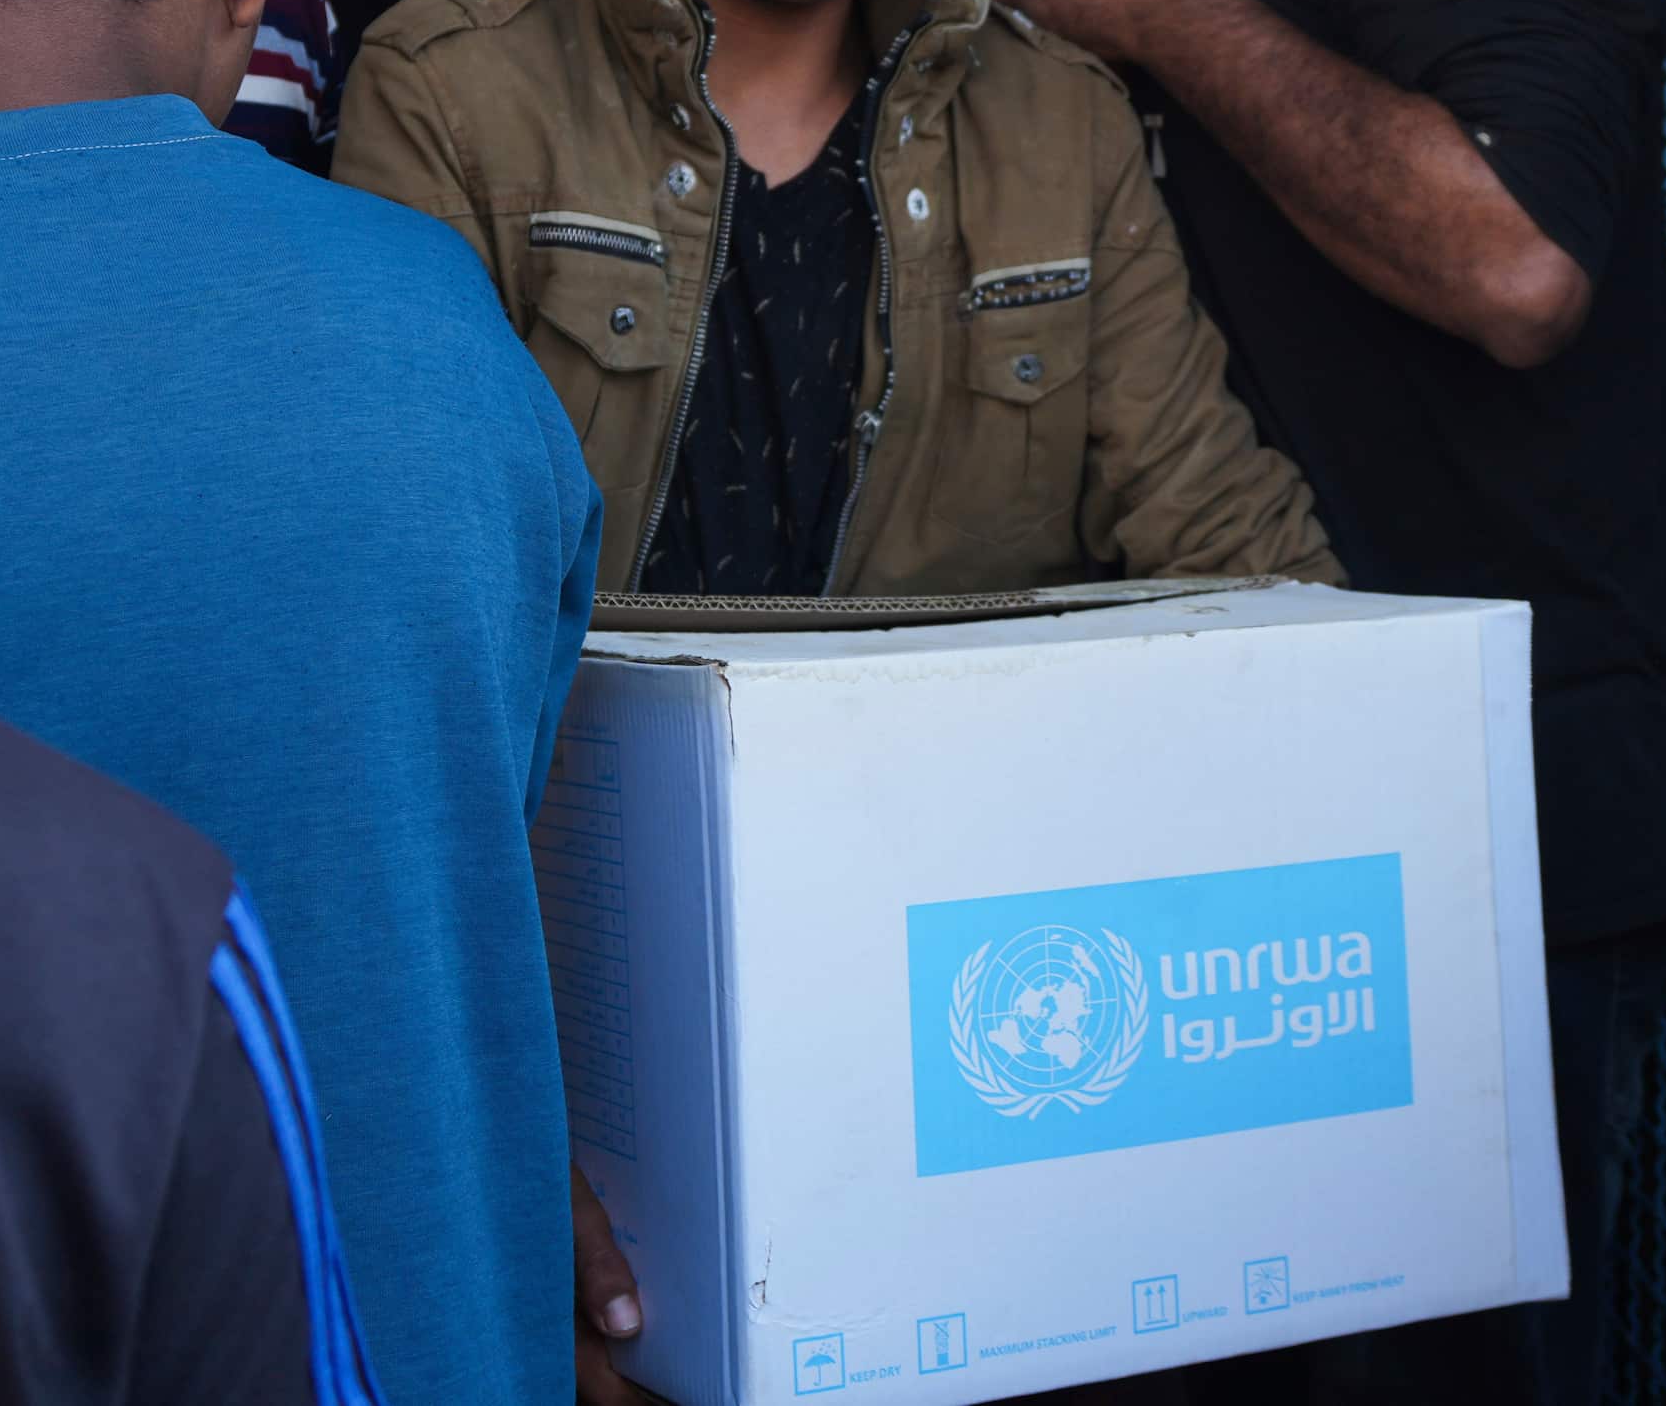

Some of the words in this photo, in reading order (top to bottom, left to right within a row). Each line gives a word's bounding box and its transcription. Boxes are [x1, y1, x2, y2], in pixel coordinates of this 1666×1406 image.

[1159, 931, 1373, 1000] unrwa
[1183, 1306, 1229, 1323] UPWARD
[979, 1341, 1034, 1359] MAXIMUM
[1036, 1332, 1088, 1351] STACKING
[1089, 1325, 1118, 1341] LIMIT
[849, 1367, 877, 1385] KEEP
[879, 1364, 902, 1381] DRY
